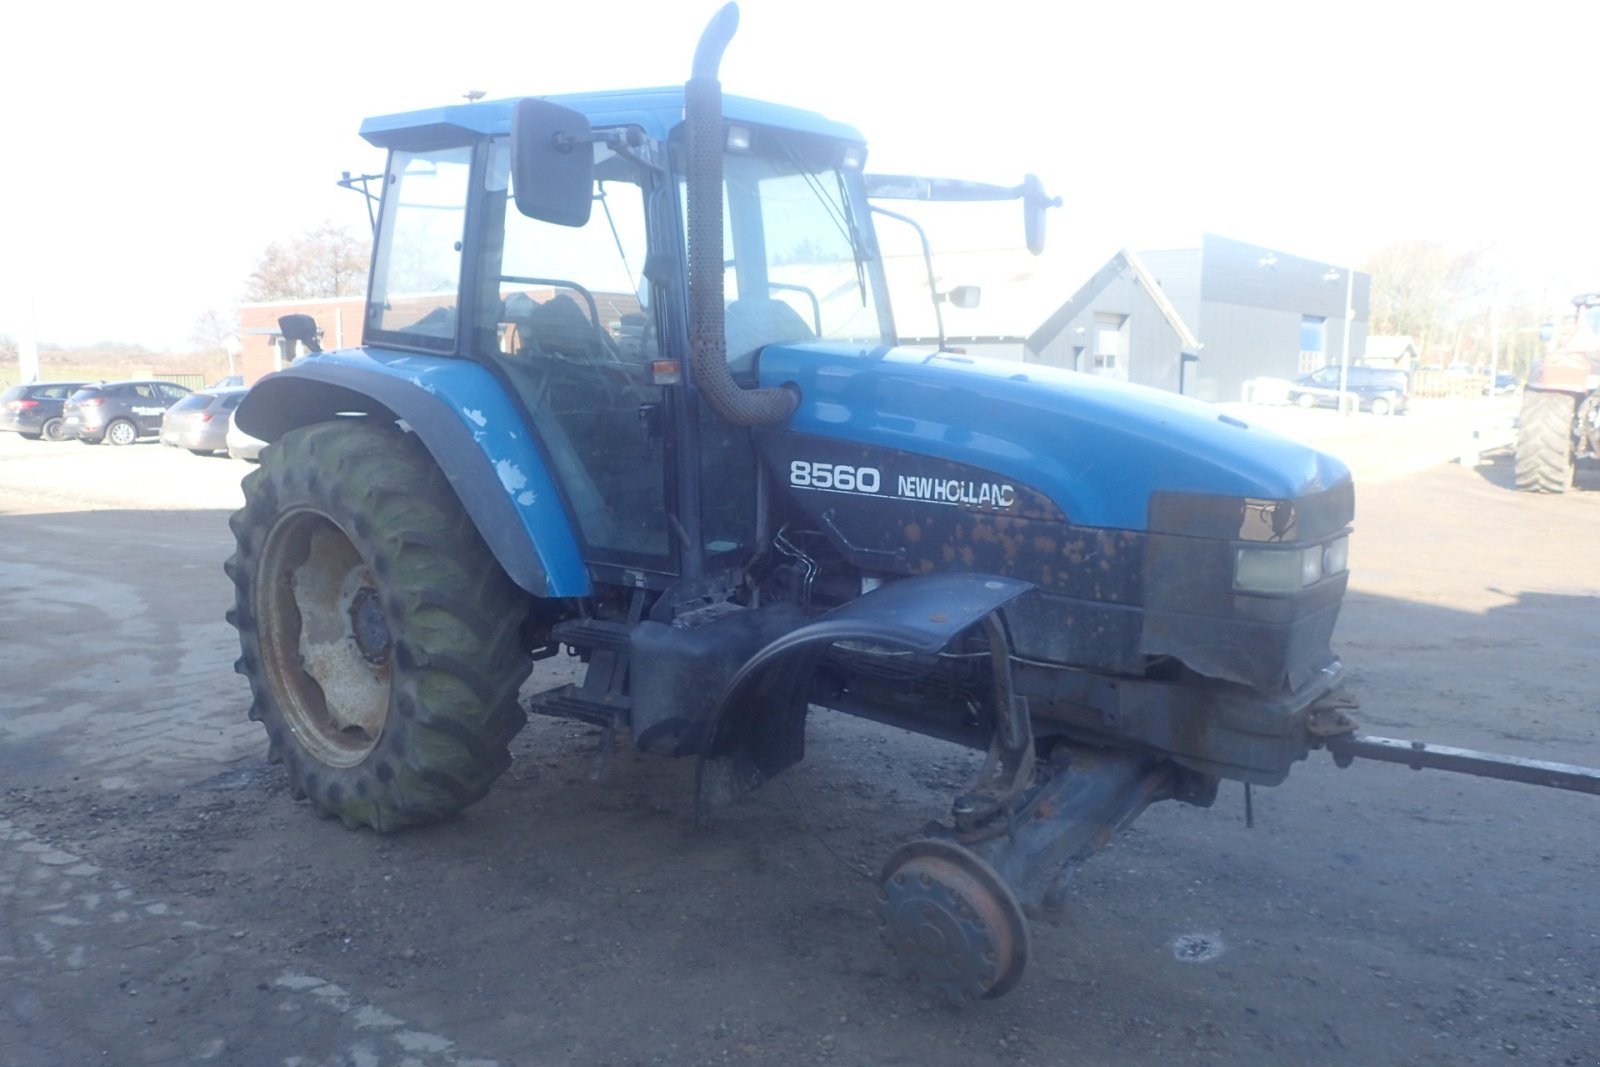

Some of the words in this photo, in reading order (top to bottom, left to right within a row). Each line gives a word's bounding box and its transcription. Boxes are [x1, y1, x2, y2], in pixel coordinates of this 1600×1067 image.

[790, 460, 881, 493] 8560
[898, 475, 933, 499] NEW
[934, 478, 1014, 507] HOLLAND
